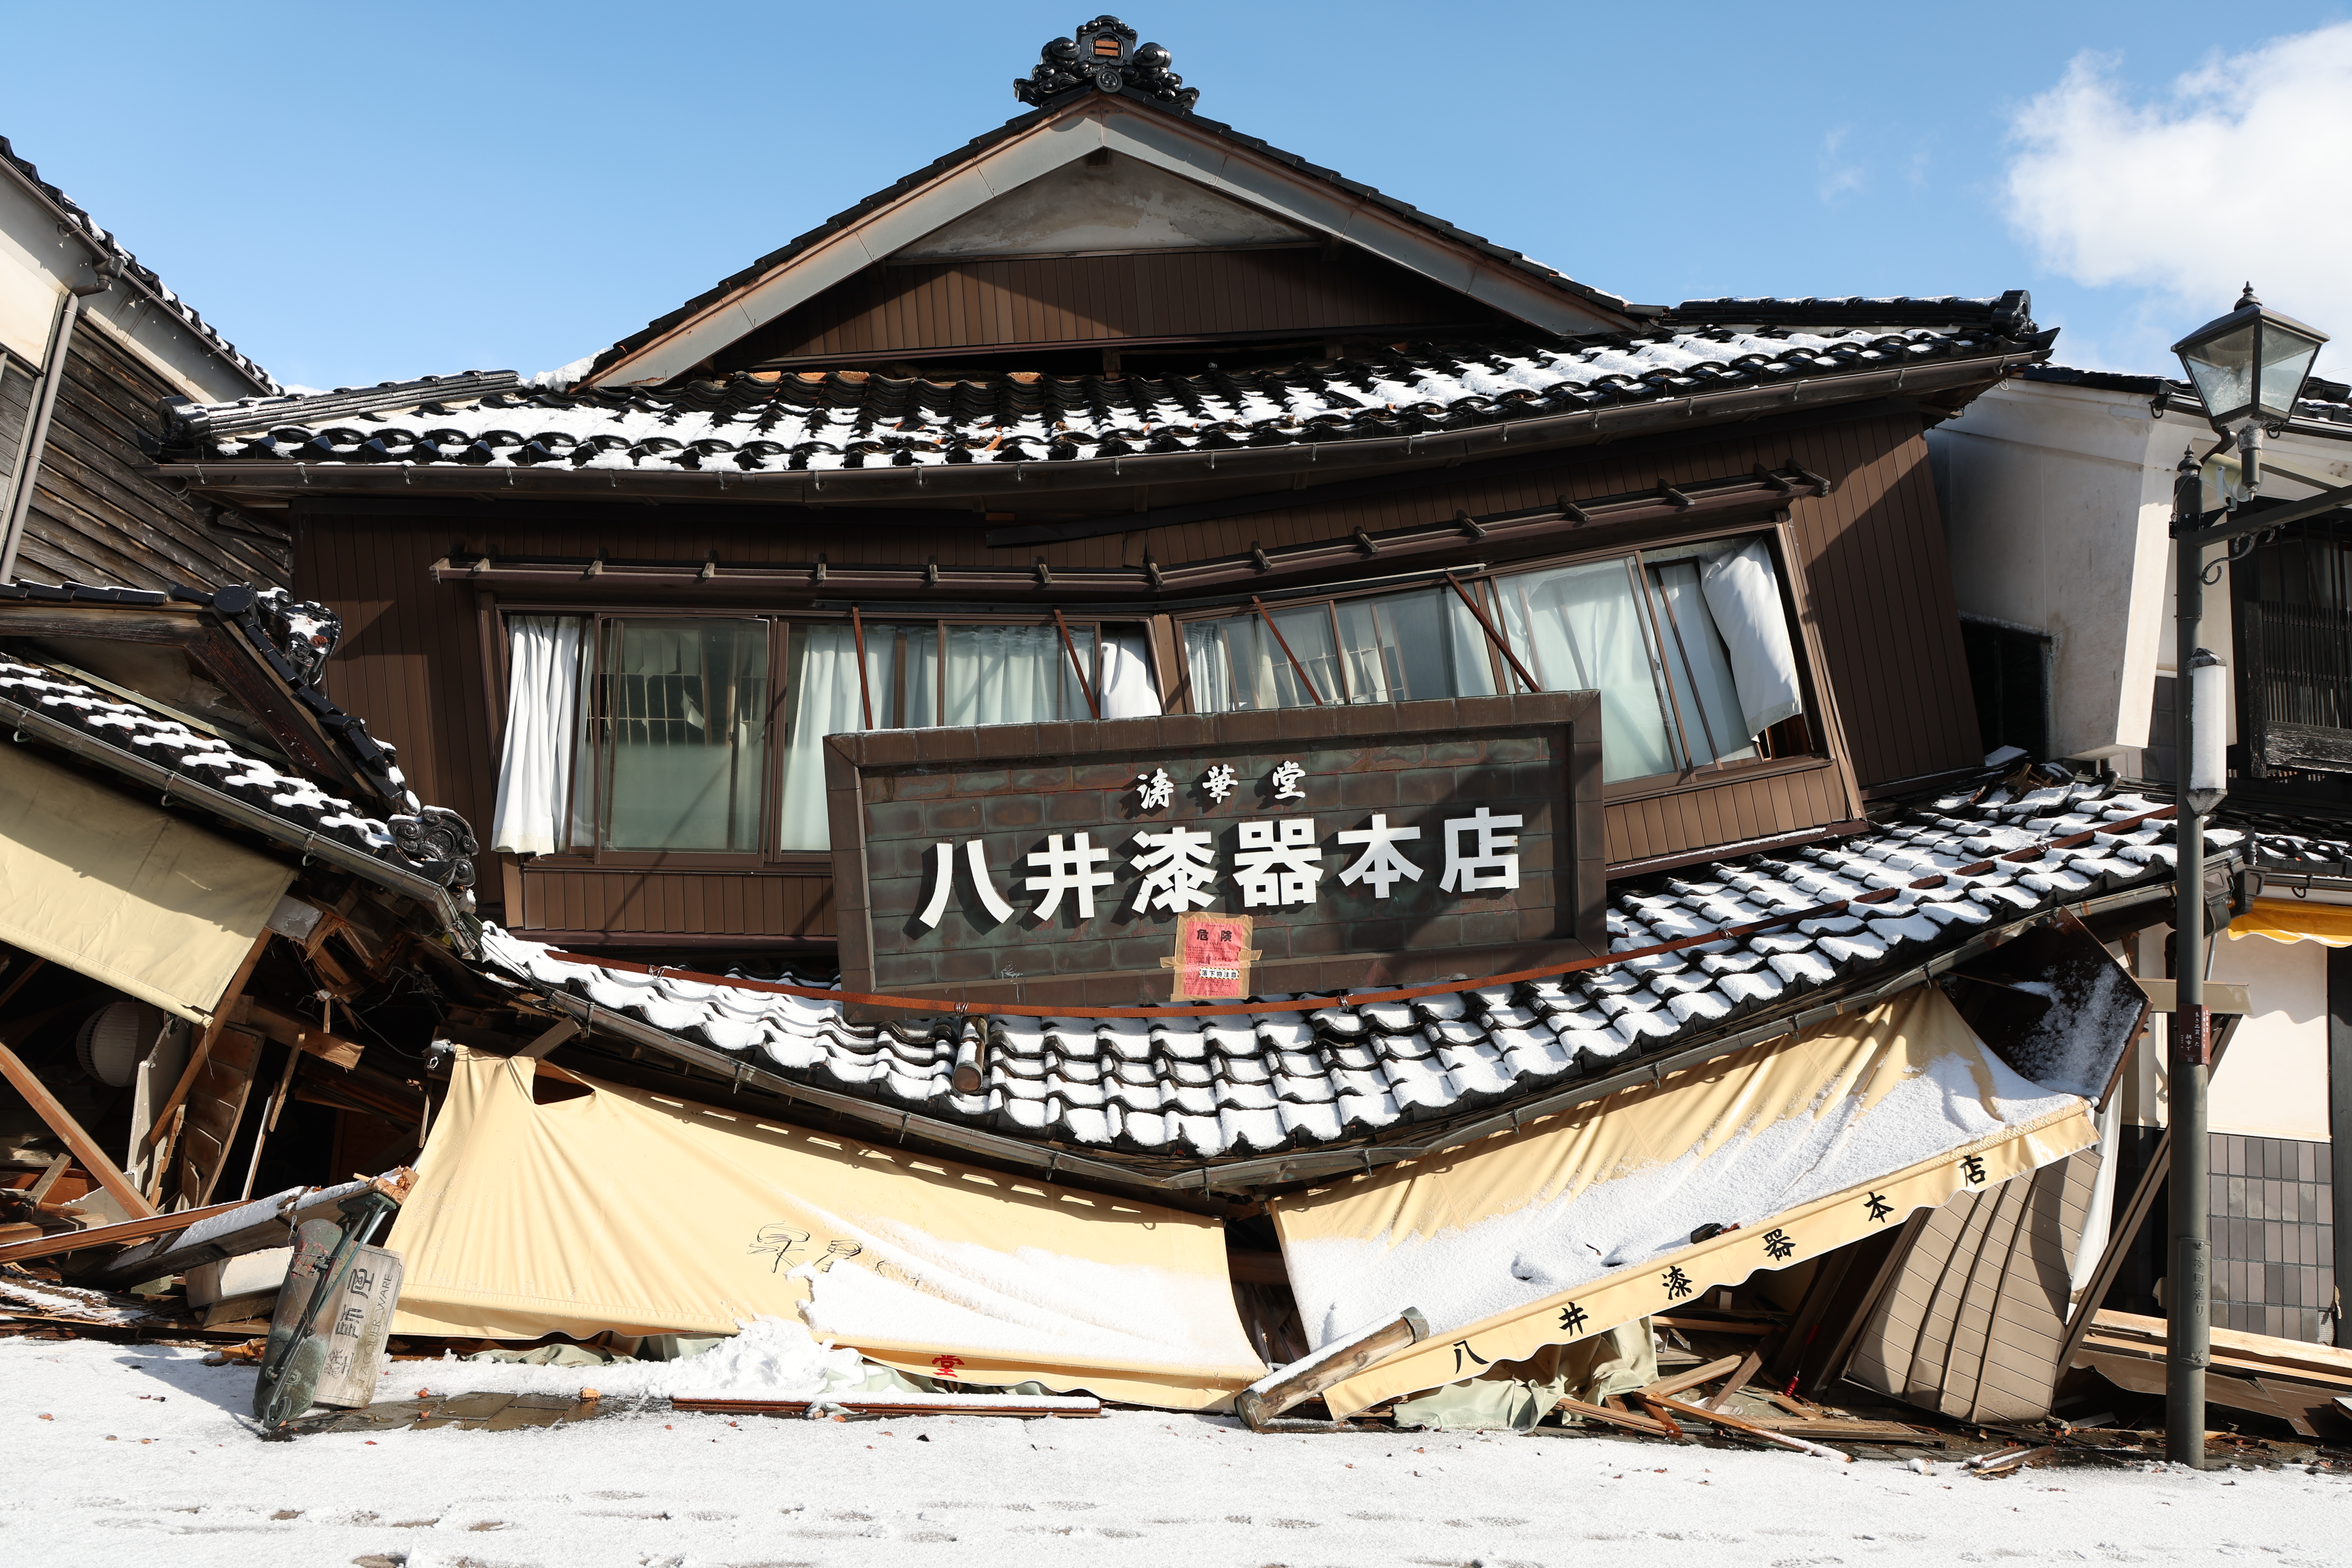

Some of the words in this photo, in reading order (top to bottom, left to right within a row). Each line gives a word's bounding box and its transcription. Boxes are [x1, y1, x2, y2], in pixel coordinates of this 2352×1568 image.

[919, 807, 1523, 929] 八井漆器本店
[1197, 929, 1232, 942] 危険
[1454, 1155, 1986, 1374] 八井漆器本店
[2193, 1256, 2206, 1317] 本町通り
[358, 1319, 383, 1382] LACQUER
[375, 1274, 393, 1310] WARE
[932, 1354, 965, 1378] 堂
